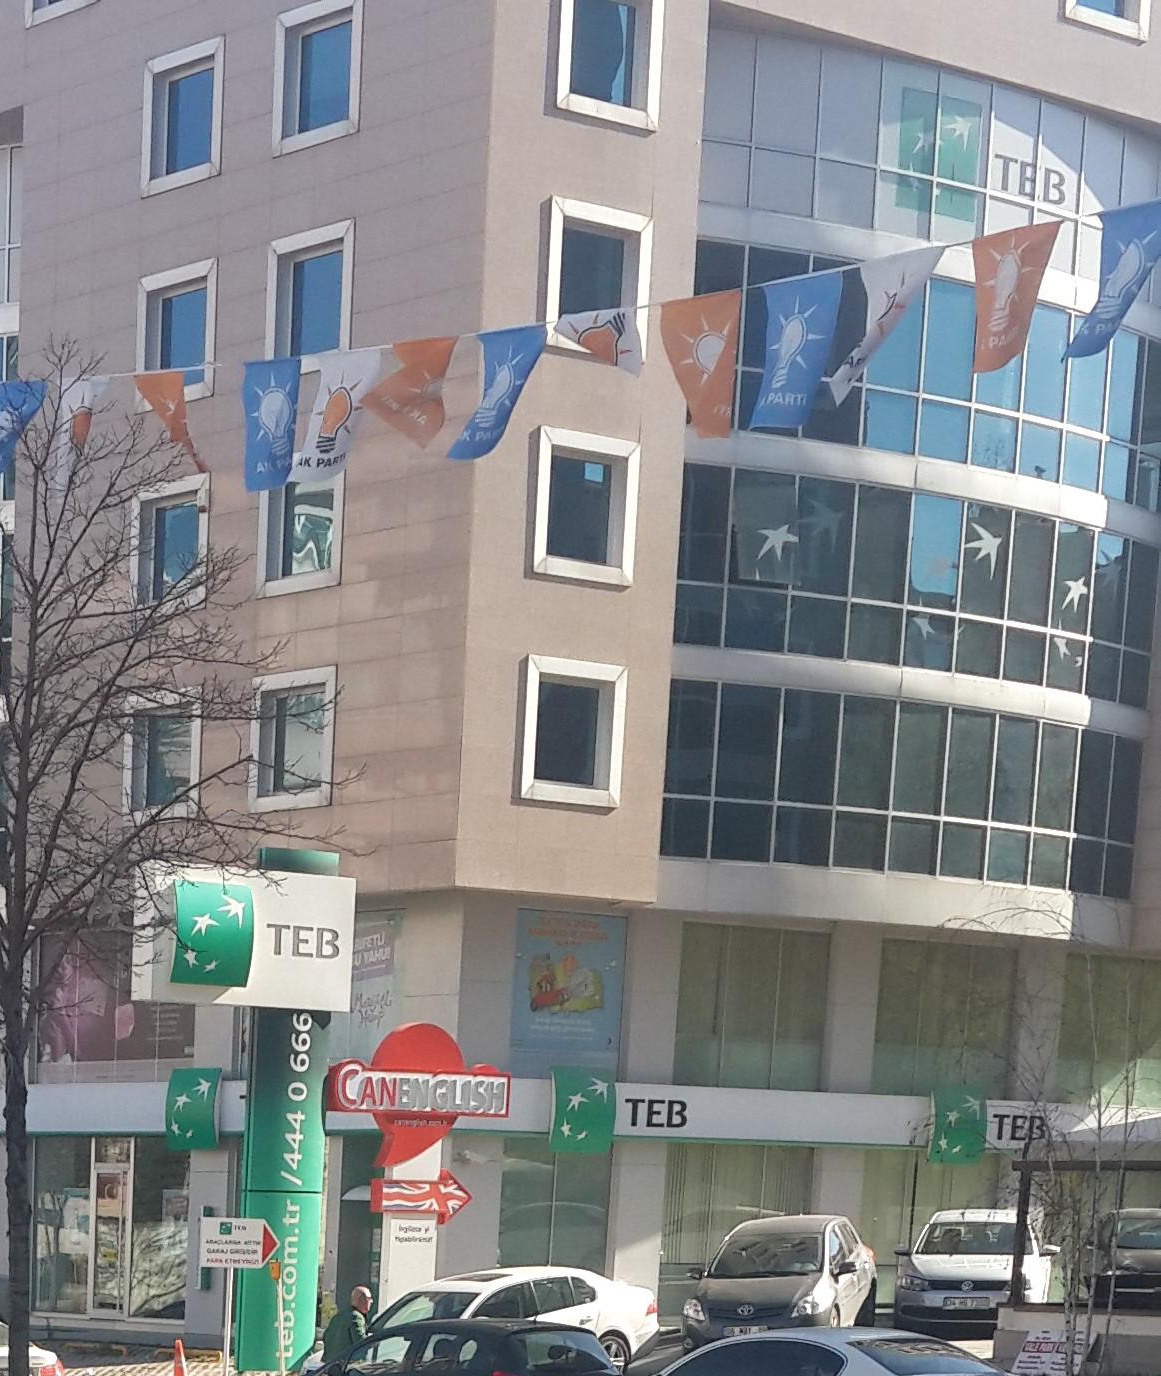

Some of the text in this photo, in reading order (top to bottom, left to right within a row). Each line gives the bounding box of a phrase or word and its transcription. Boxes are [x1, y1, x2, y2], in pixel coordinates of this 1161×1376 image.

[995, 154, 1066, 205] TEB
[266, 922, 341, 960] TEB
[289, 1011, 313, 1073] 666
[287, 1081, 308, 1102] 0
[624, 1098, 688, 1128] TEB
[992, 1113, 1047, 1141] TEB
